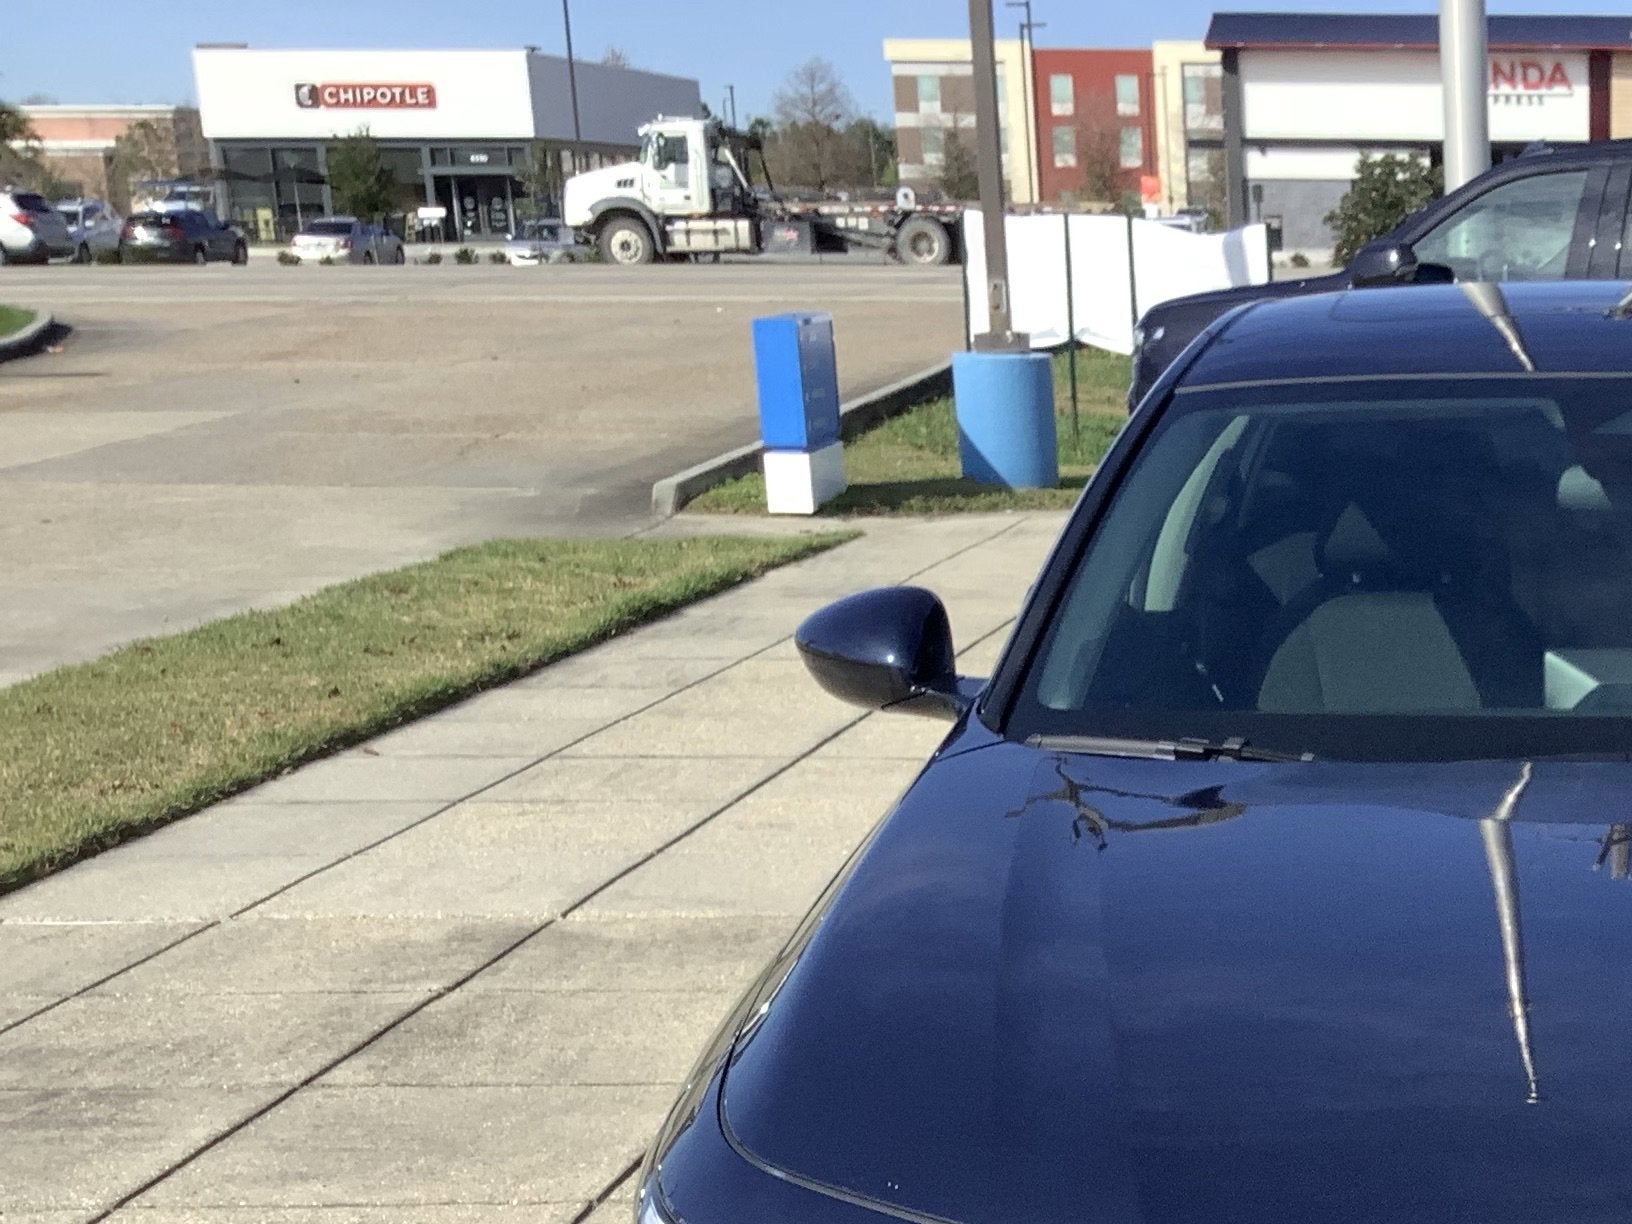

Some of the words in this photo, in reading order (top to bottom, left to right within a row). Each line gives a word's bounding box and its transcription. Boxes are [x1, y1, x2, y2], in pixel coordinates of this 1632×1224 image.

[1492, 60, 1572, 91] NDA
[323, 86, 430, 105] CHIPOTLE
[1493, 94, 1545, 106] PRESS
